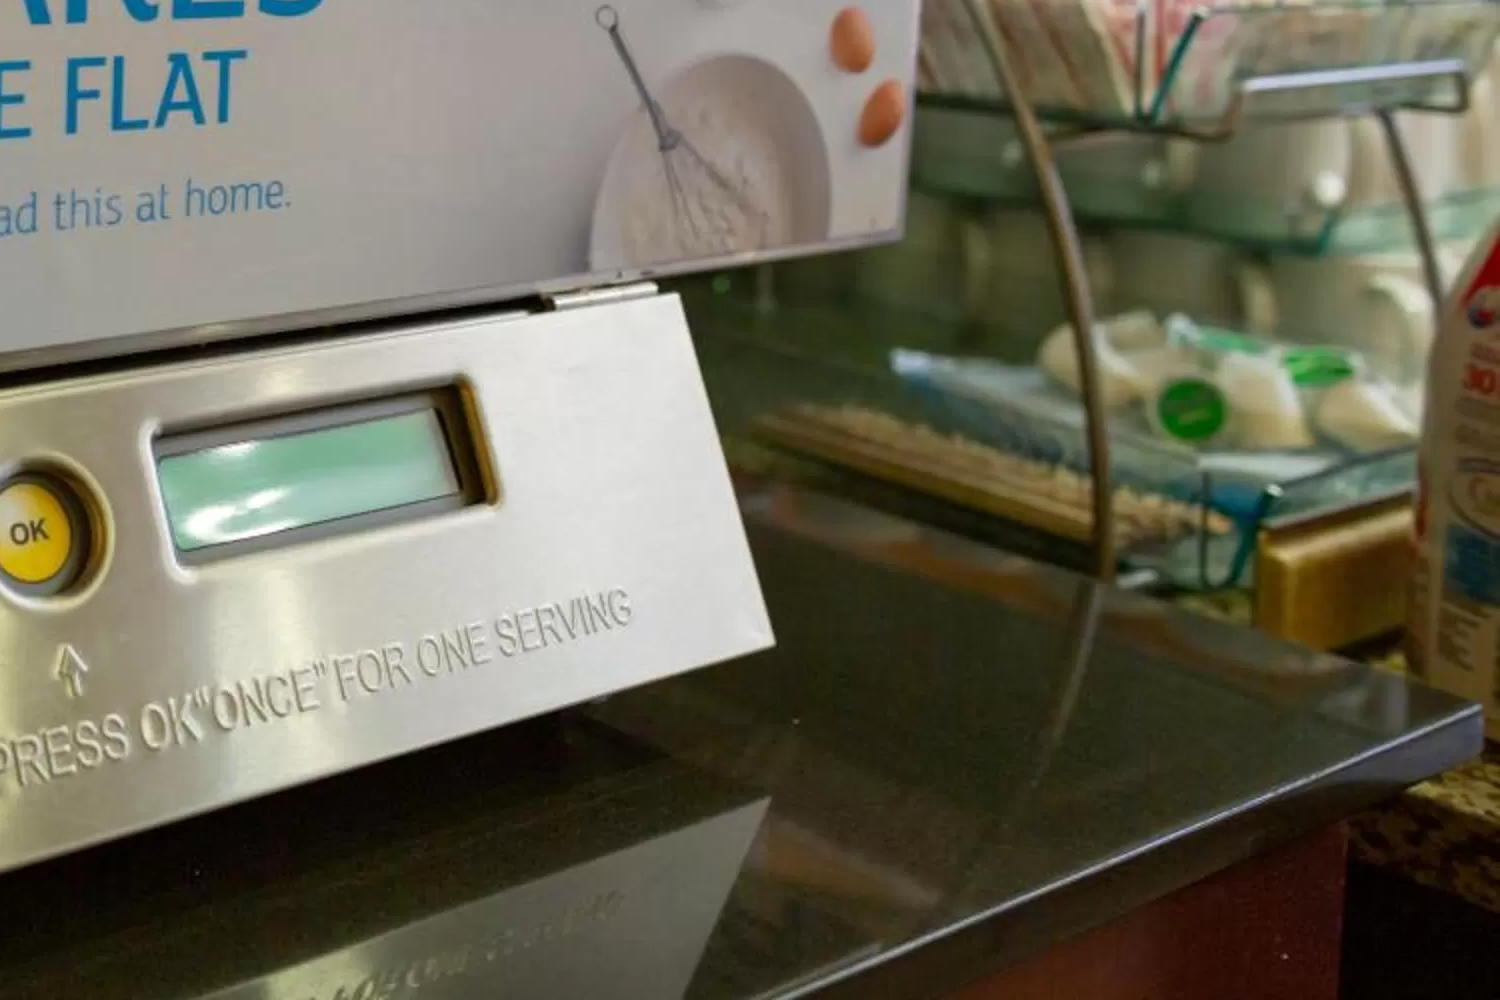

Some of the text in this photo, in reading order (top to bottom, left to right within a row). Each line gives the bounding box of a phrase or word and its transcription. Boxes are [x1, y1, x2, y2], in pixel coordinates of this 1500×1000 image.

[64, 49, 248, 136] FLAT
[52, 187, 123, 231] this
[135, 184, 172, 222] at
[184, 177, 293, 217] home.
[9, 518, 50, 547] OK
[139, 694, 203, 751] OK
[331, 639, 412, 702] FOR
[415, 620, 493, 679] ONE
[493, 586, 633, 659] SERVING
